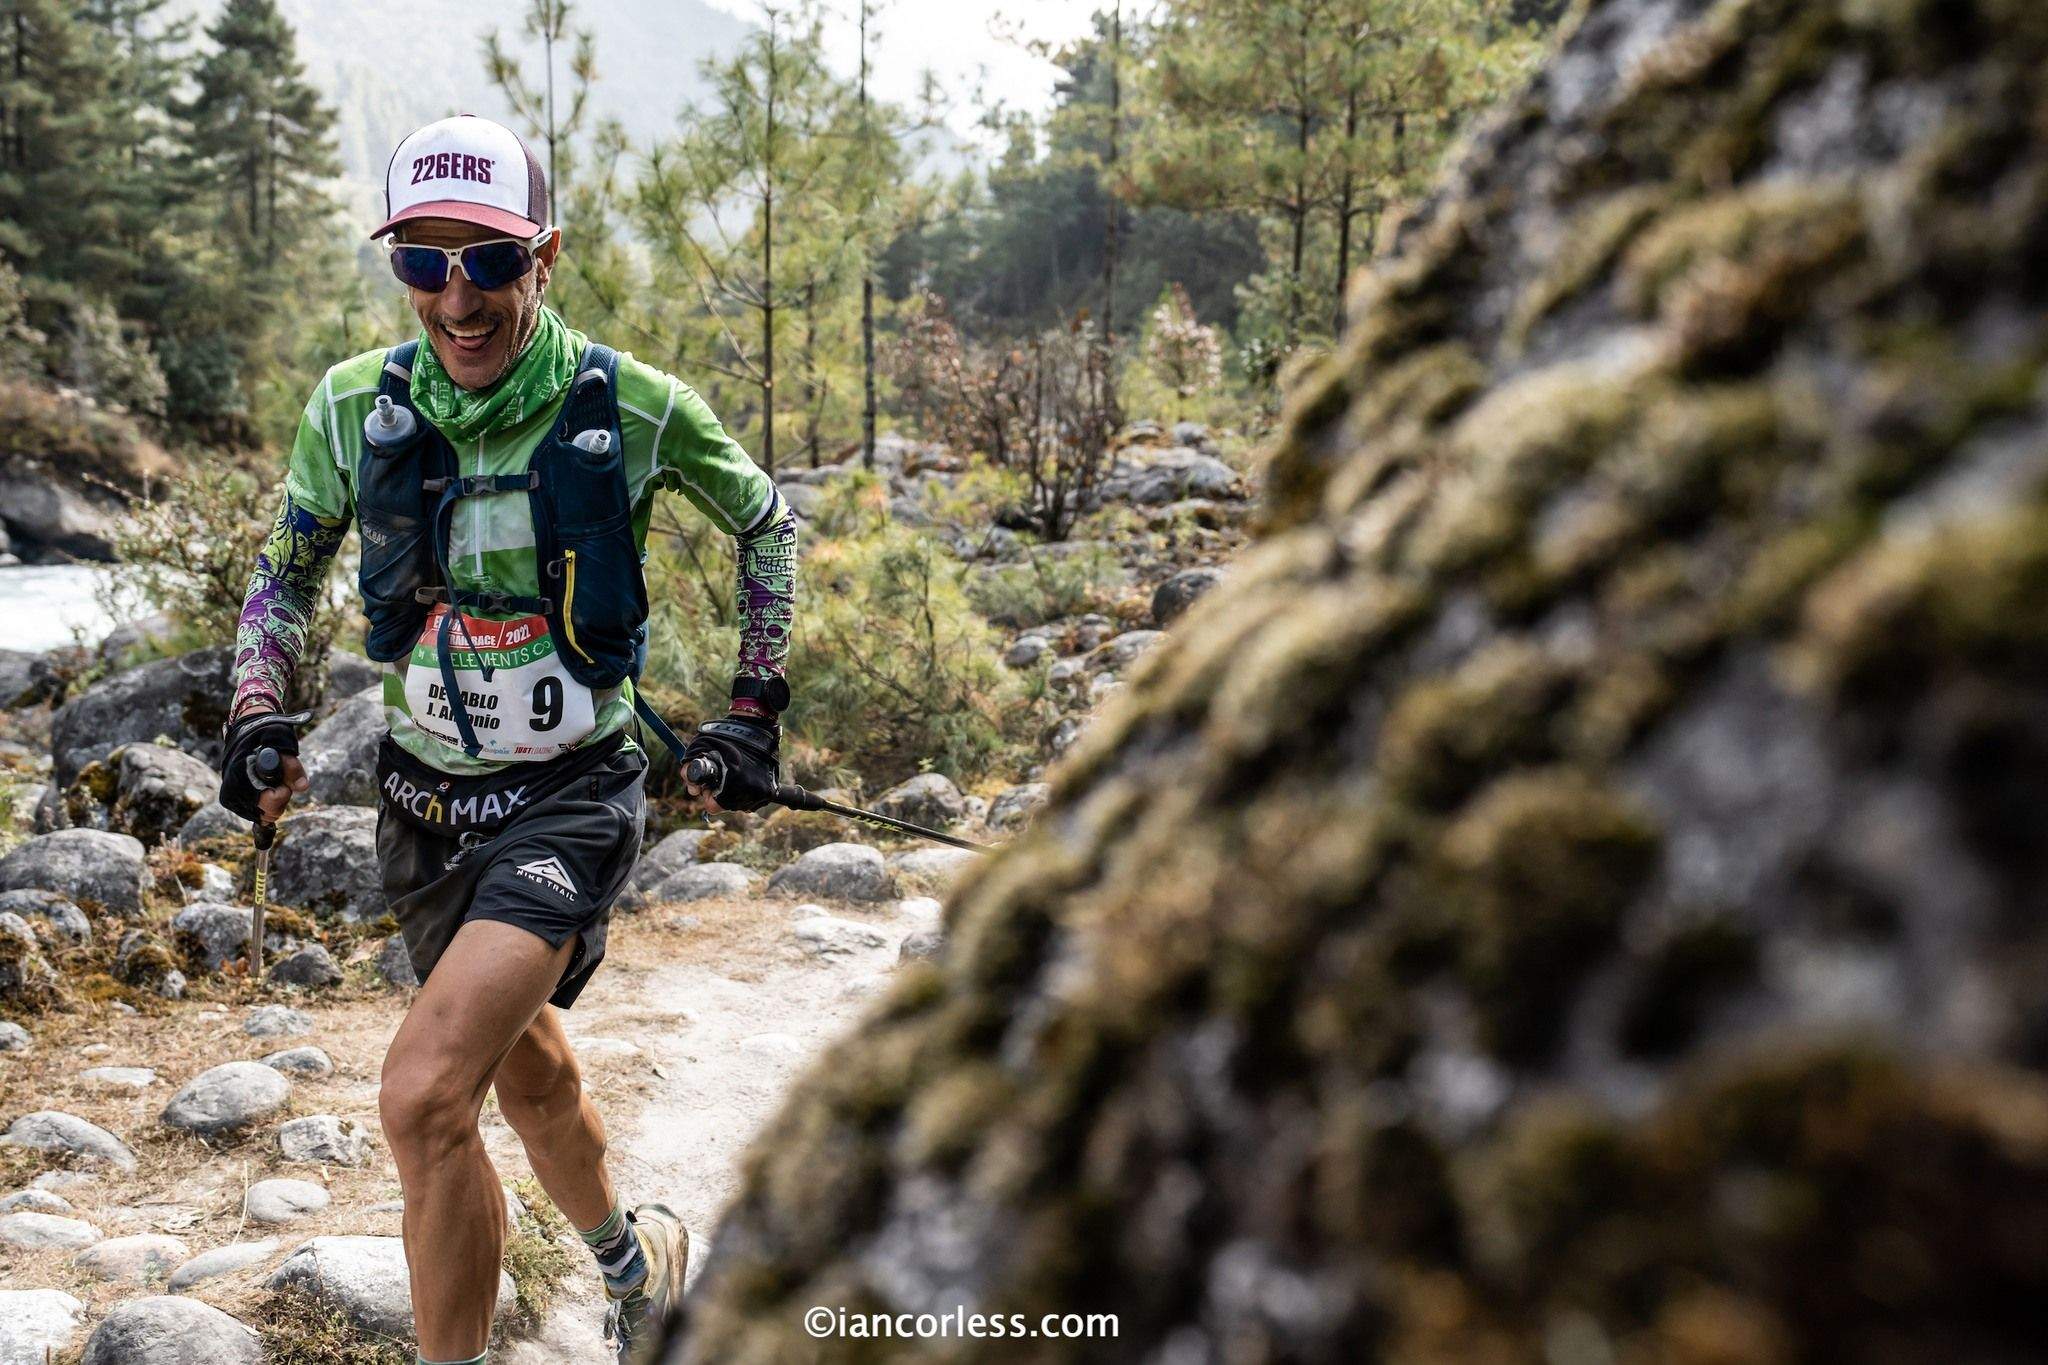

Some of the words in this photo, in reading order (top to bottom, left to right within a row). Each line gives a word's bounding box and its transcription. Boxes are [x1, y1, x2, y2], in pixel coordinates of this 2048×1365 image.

[411, 153, 491, 185] 226ERS
[428, 683, 446, 701] DE
[460, 691, 499, 710] ABLO
[529, 675, 563, 732] 9
[426, 702, 436, 717] J.
[439, 705, 500, 730] Anonio
[255, 868, 266, 905] SCOTT
[516, 868, 543, 884] NIKE
[546, 879, 575, 902] TRAIL
